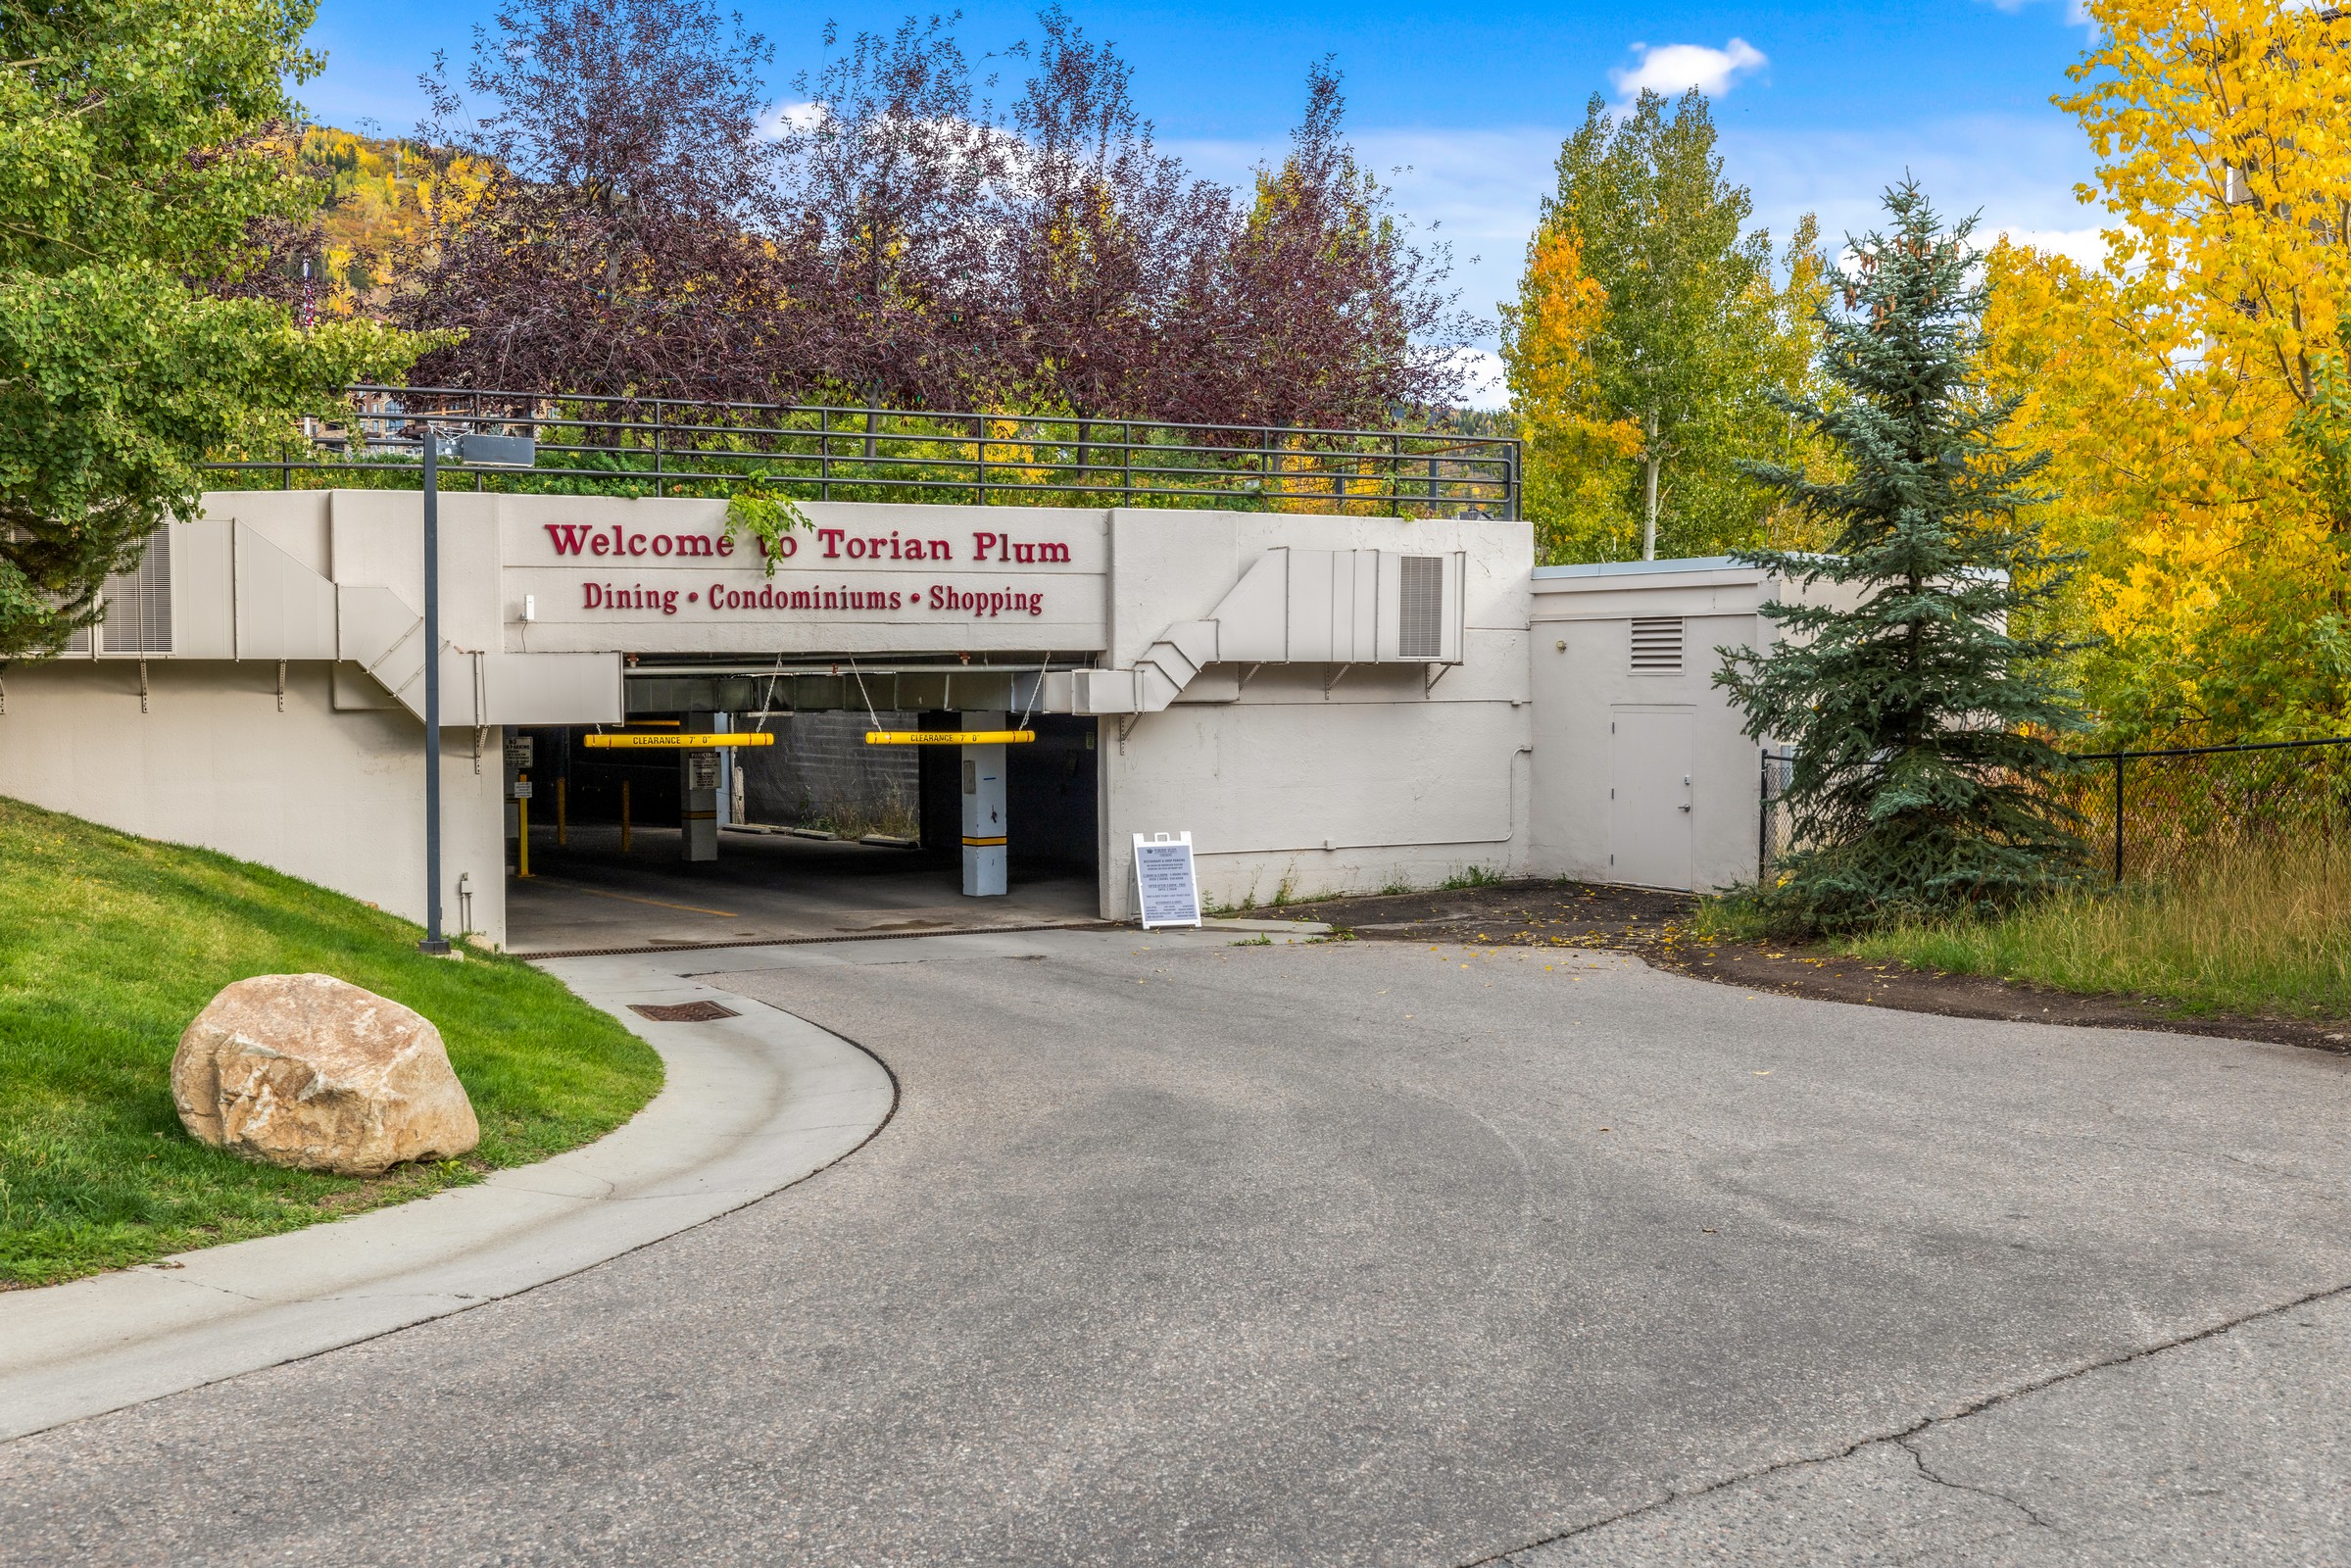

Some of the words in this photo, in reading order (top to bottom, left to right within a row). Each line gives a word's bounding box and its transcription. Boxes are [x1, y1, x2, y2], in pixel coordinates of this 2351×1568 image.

[544, 523, 735, 557] Welcome
[756, 533, 798, 558] to
[818, 528, 953, 560] Torian
[973, 532, 1071, 564] Plum
[583, 582, 679, 614] Dining
[710, 583, 902, 611] Condominiums
[930, 584, 1044, 616] Shopping
[632, 736, 681, 745] CLEARANCE
